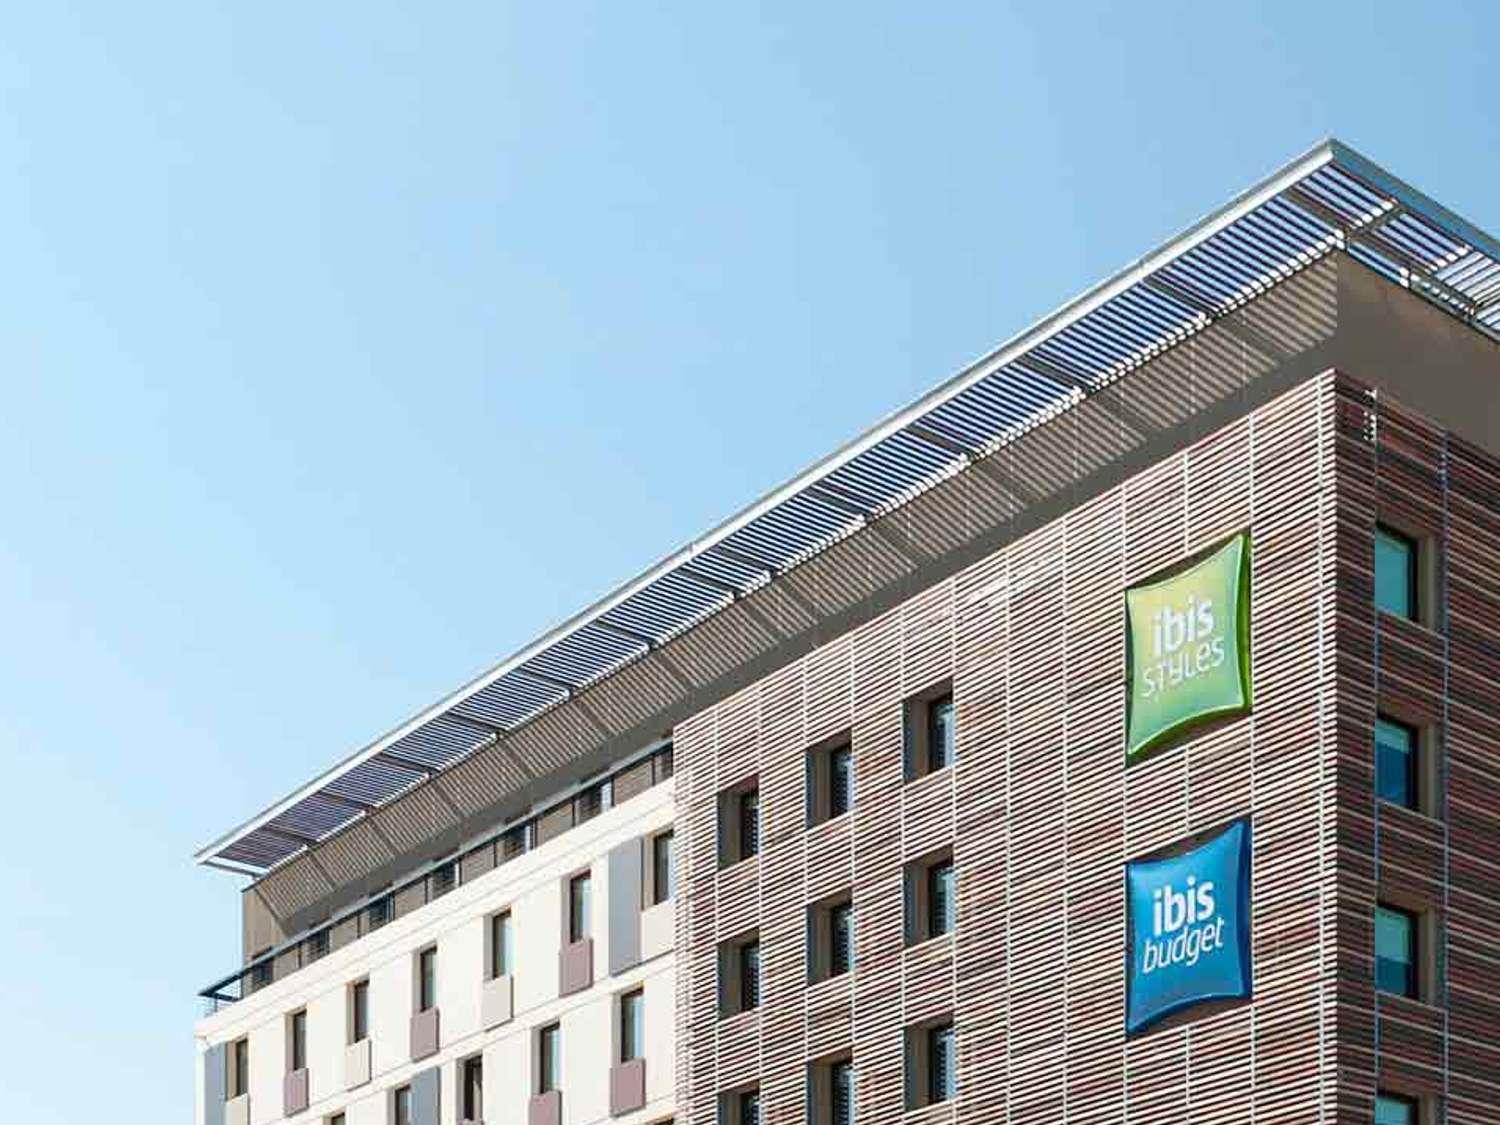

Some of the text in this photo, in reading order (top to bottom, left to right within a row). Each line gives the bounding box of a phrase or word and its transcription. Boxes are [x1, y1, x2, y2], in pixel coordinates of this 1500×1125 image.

[1153, 594, 1214, 657] ibis
[1154, 875, 1214, 936] ibis
[1143, 916, 1224, 974] budget
